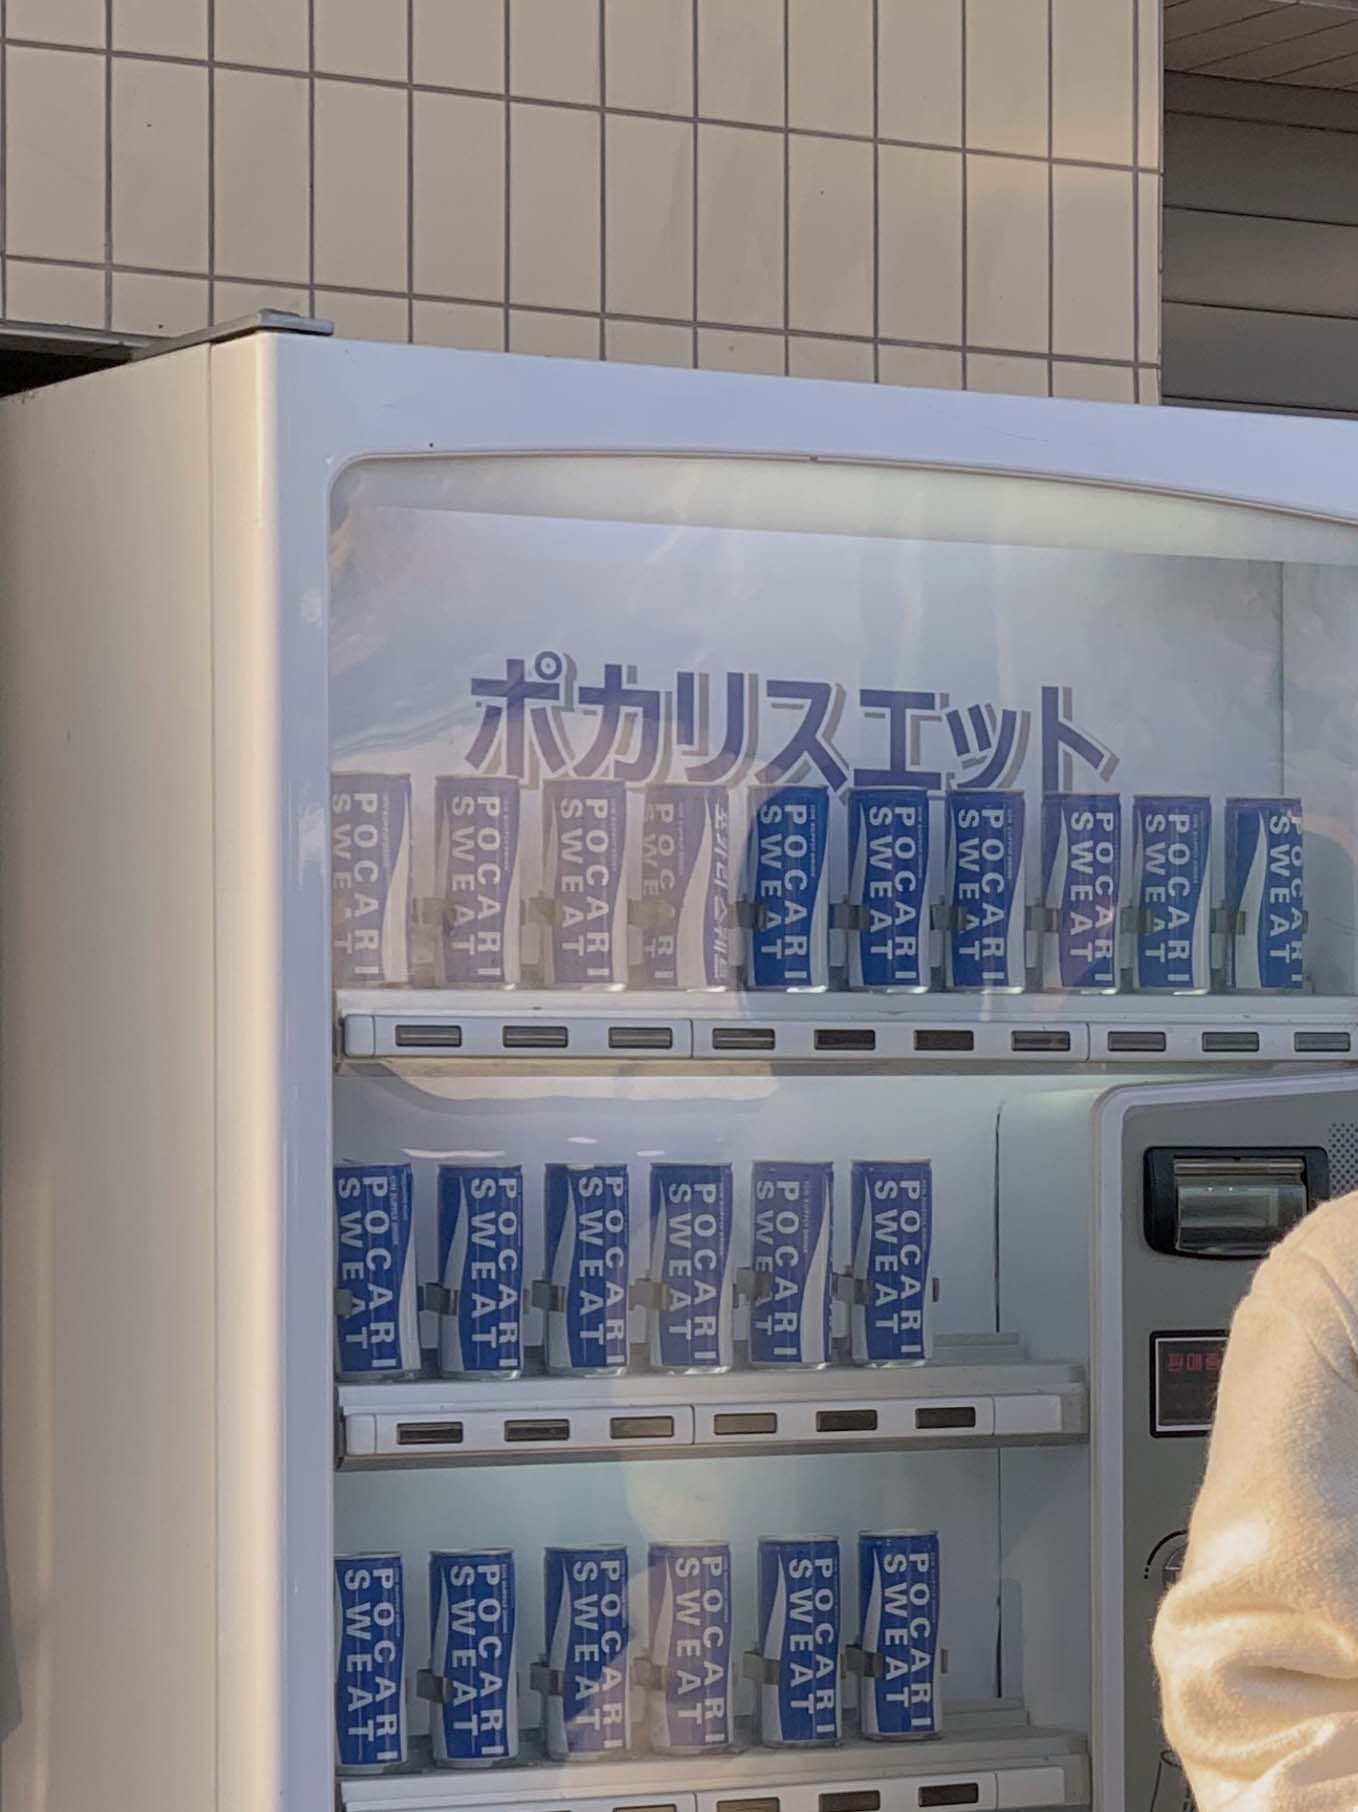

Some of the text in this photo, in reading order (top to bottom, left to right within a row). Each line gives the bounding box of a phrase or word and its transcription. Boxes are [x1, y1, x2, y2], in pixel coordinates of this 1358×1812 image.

[464, 650, 1110, 792] ポカリスエット
[354, 793, 379, 974] POCARI
[452, 796, 475, 955] SWEAT
[477, 796, 501, 975] POCARI
[560, 799, 584, 956] SWEAT
[586, 799, 609, 976] POCARI
[655, 803, 675, 978] POCRI
[784, 804, 808, 979] POCARI
[869, 807, 892, 960] SWEAT
[894, 807, 917, 979] POCARI
[981, 809, 1005, 980] POCARI
[1070, 812, 1093, 962] SWEAT
[1095, 812, 1114, 980] POCARI
[1167, 814, 1190, 981] POCARI
[1269, 816, 1290, 963] SWEAT
[363, 1176, 396, 1368] POCARI
[470, 1178, 496, 1348] SWEAT
[498, 1178, 518, 1367] POCARI
[578, 1176, 604, 1344] SWEAT
[605, 1176, 625, 1364] POCARI
[668, 1184, 692, 1340] SWEAT
[693, 1184, 717, 1359] POCARI
[774, 1181, 800, 1355] POCARI
[875, 1180, 898, 1334] SWEAT
[900, 1180, 921, 1353] POCARI
[344, 1569, 374, 1742] SWEAT
[372, 1568, 398, 1760] POCARI
[451, 1565, 478, 1736] SWEAT
[477, 1564, 504, 1755] POCARI
[573, 1561, 600, 1730] SWEAT
[600, 1560, 623, 1748] POCARI
[675, 1557, 703, 1724] SWEAT
[702, 1556, 725, 1744] POCARI
[789, 1558, 814, 1714] SWEAT
[814, 1558, 835, 1732] POCARI
[883, 1554, 909, 1708] SWEAT
[909, 1552, 932, 1726] POCARI
